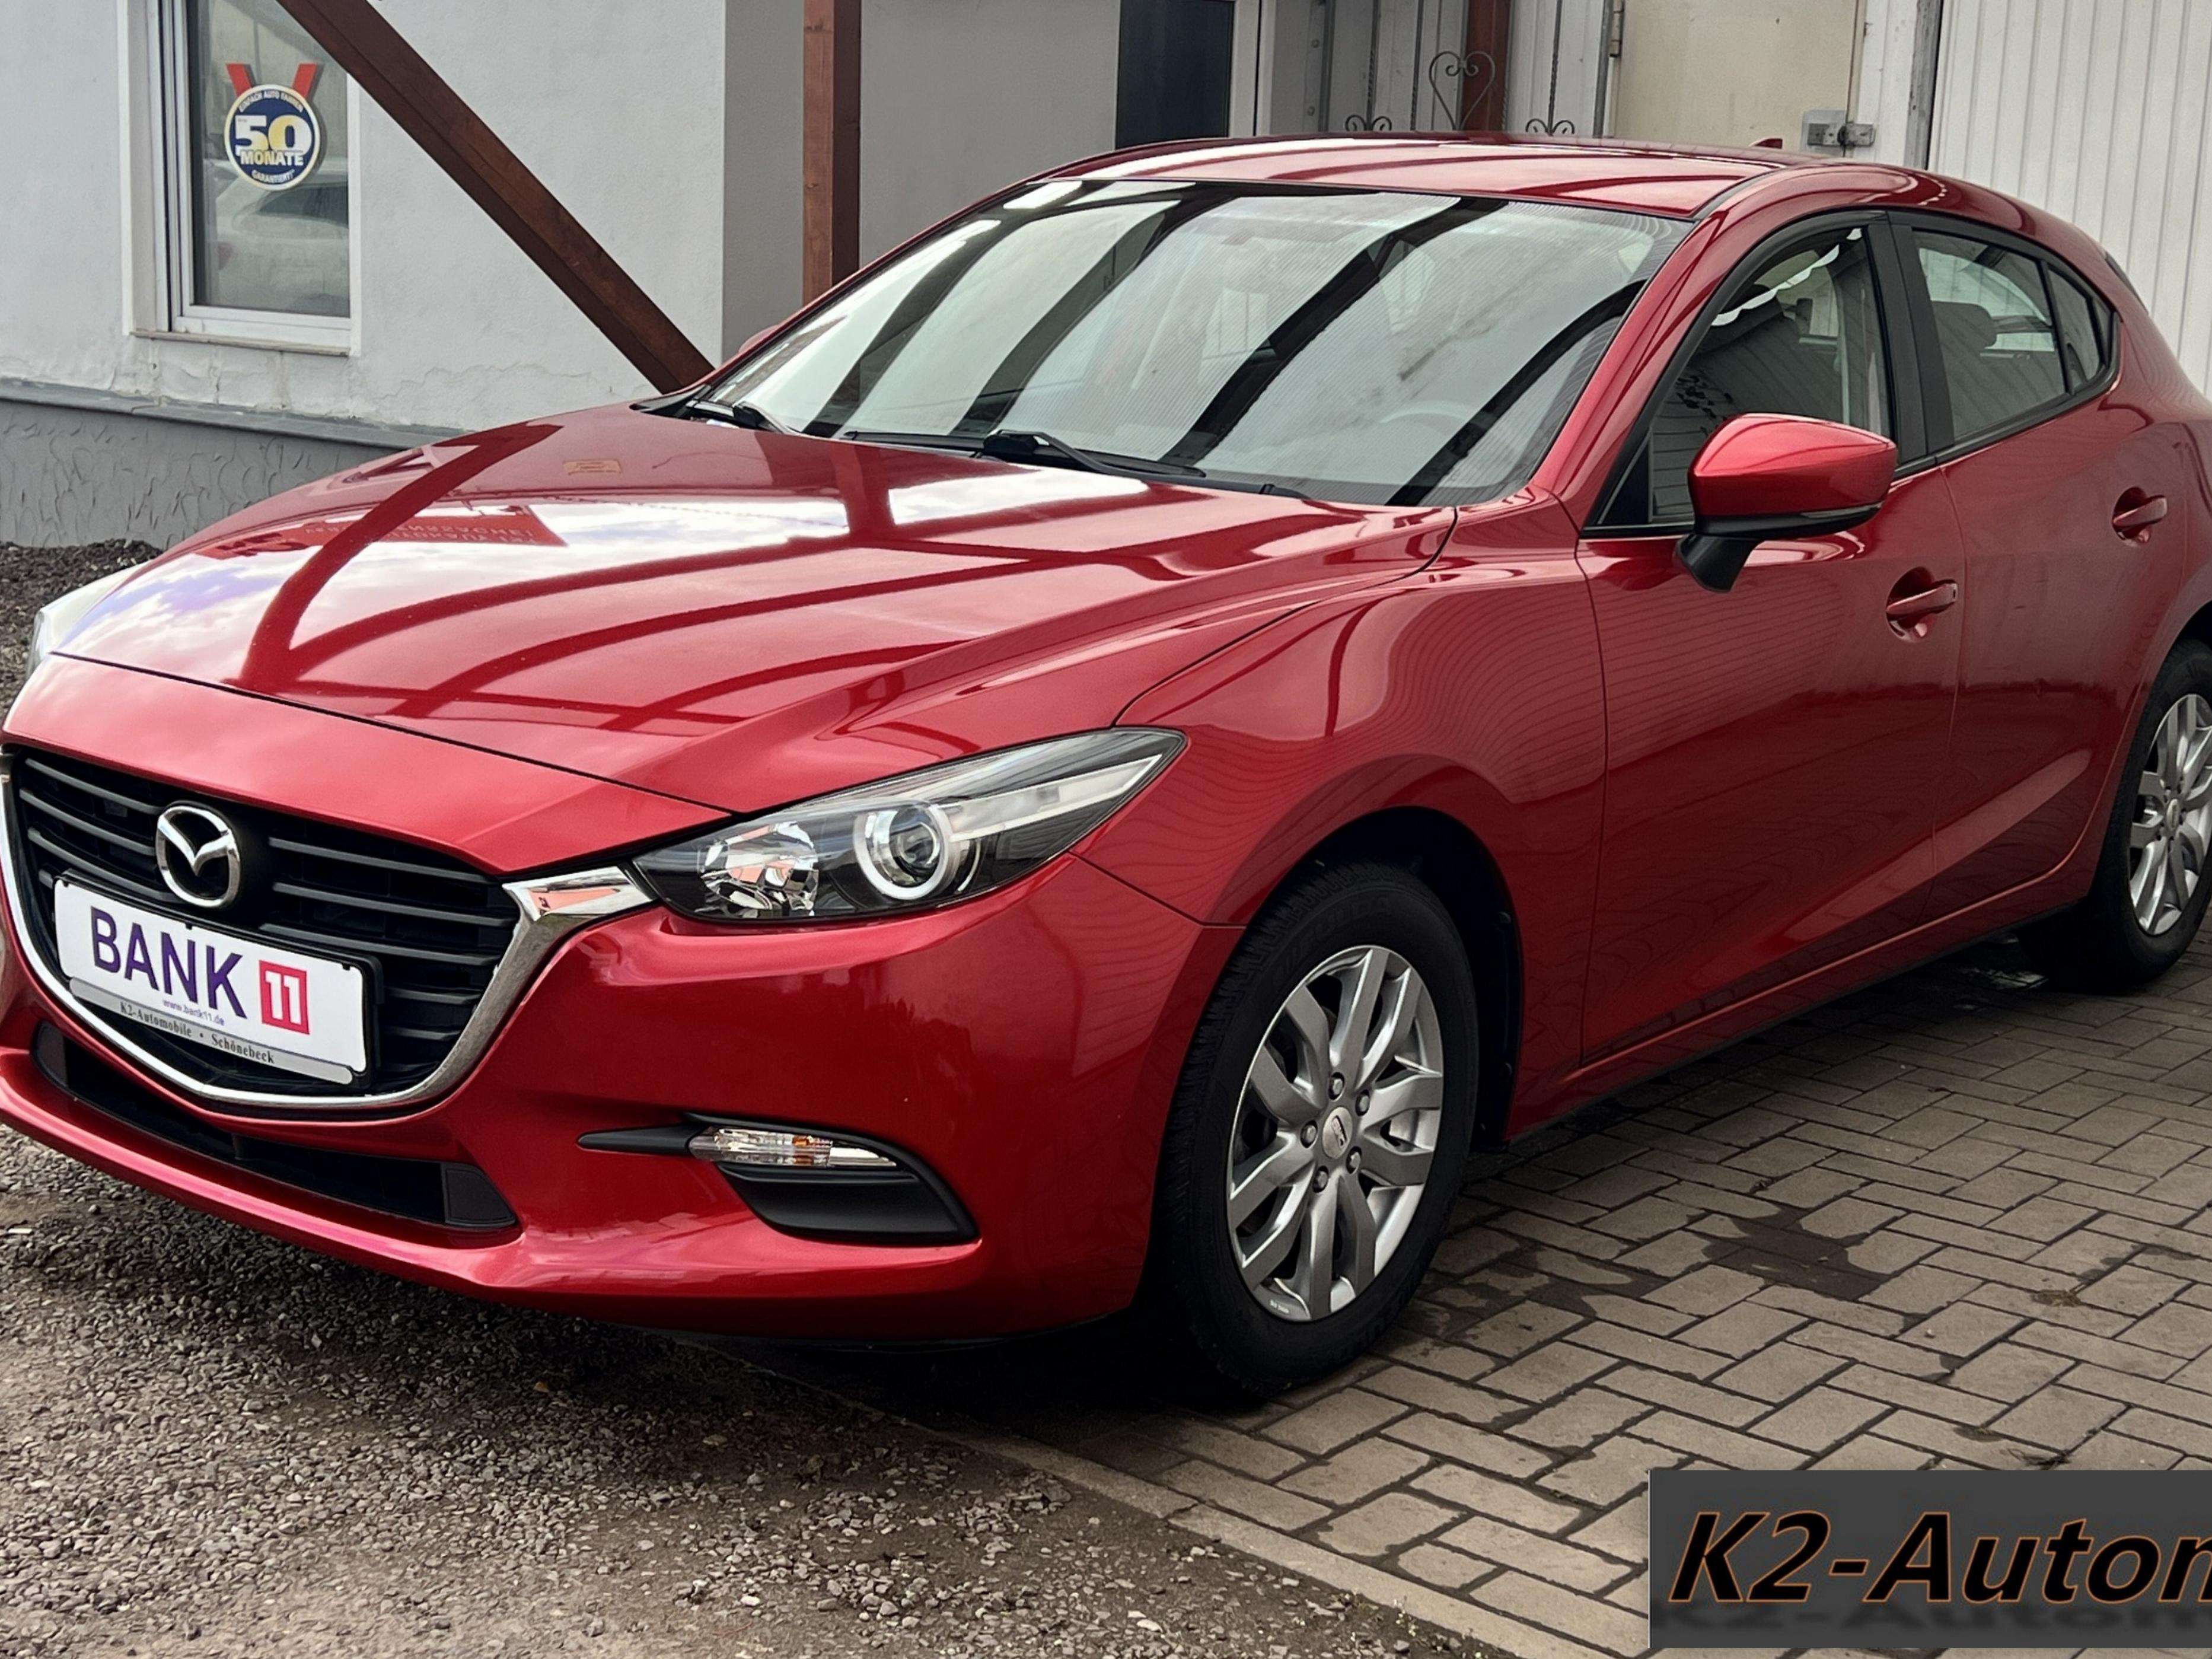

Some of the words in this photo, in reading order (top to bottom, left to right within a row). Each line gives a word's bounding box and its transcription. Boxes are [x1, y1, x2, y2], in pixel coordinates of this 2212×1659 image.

[235, 114, 312, 157] 50
[240, 150, 304, 166] MONATE
[90, 905, 247, 1020] BANK
[263, 966, 304, 1028] 11
[120, 1001, 192, 1038] K2-Automobile
[211, 1033, 275, 1063] Schönebeck
[162, 999, 225, 1027] www.bank11.de
